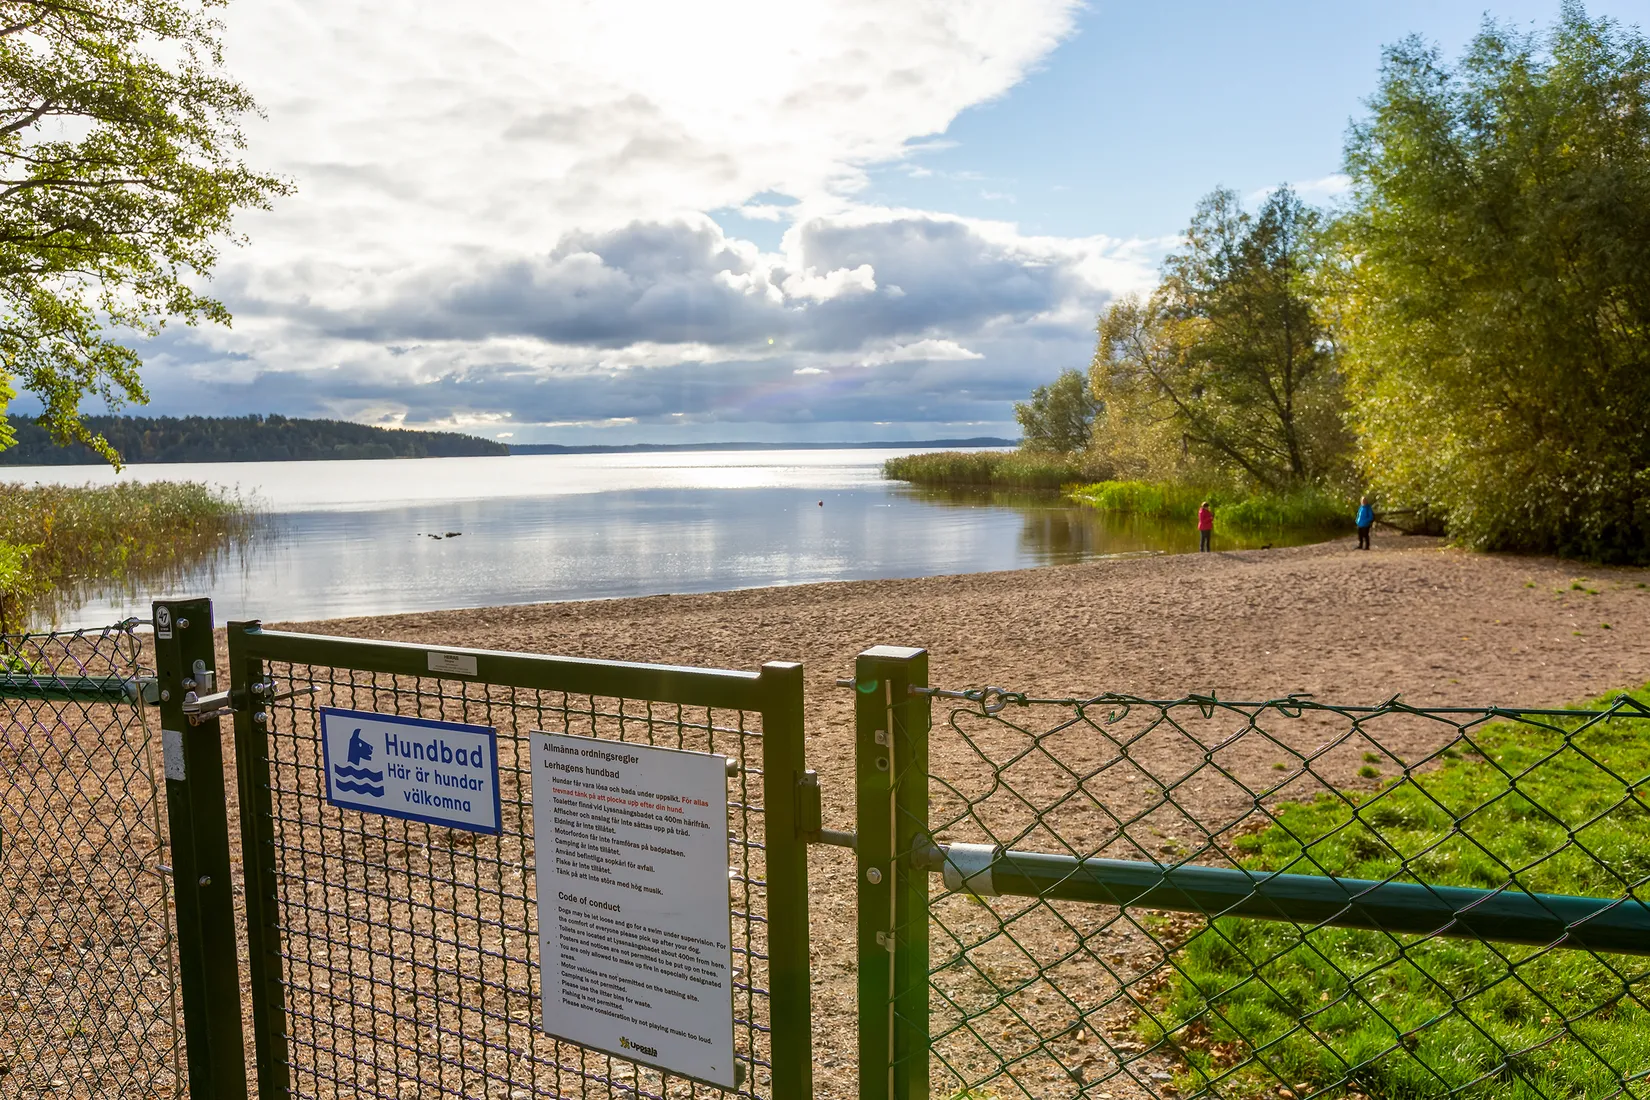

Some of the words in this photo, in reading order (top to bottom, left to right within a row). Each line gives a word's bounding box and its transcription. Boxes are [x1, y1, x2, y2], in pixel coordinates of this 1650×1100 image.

[385, 733, 484, 768] Hundbad
[543, 743, 580, 755] Allmänna
[580, 749, 639, 764] ordningsregler
[388, 763, 411, 780] Här
[416, 767, 430, 783] är
[435, 770, 484, 791] hundar
[543, 760, 585, 773] Lerhagens
[584, 766, 620, 779] hundbad
[404, 788, 471, 812] välkomna
[551, 776, 573, 785] Hundar
[572, 779, 582, 787] får
[595, 783, 609, 791] lösa
[620, 787, 636, 796] bada
[636, 791, 655, 799] under
[655, 794, 681, 803] uppsikt.
[681, 796, 692, 805] För
[693, 799, 709, 807] allas
[552, 787, 574, 796] trevnad
[574, 790, 588, 799] tänk
[588, 792, 596, 800] på
[596, 793, 606, 802] att
[606, 796, 627, 805] plocka
[627, 799, 640, 808] upp
[639, 801, 655, 809] efter
[655, 803, 666, 811] din
[666, 805, 685, 815] hund.
[552, 796, 578, 807] Toaletter
[578, 801, 593, 810] finns
[592, 803, 603, 811] vid
[663, 815, 683, 825] 400m
[683, 818, 711, 829] härifrån.
[553, 807, 579, 817] Affischer
[590, 814, 611, 824] anslag
[610, 816, 620, 824] får
[620, 818, 633, 827] inte
[633, 821, 653, 830] sättas
[653, 825, 666, 833] upp
[666, 826, 675, 834] på
[675, 828, 691, 837] träd.
[553, 817, 575, 828] Eldning
[575, 820, 582, 828] är
[582, 821, 594, 830] inte
[594, 824, 617, 834] tillåtet.
[554, 827, 589, 839] Motorfordon
[589, 833, 598, 841] får
[598, 835, 611, 844] inte
[611, 838, 640, 849] framföras
[640, 843, 649, 851] på
[649, 845, 686, 857] badplatsen.
[554, 837, 580, 849] Camping
[580, 841, 587, 850] är
[587, 843, 599, 852] inte
[599, 846, 621, 856] tillåtet.
[555, 847, 576, 857] Använd
[627, 861, 636, 869] för
[636, 864, 655, 873] avfall.
[555, 857, 571, 866] Fiske
[571, 860, 578, 868] är
[578, 861, 590, 870] inte
[590, 864, 612, 875] tillåtet.
[555, 867, 570, 876] Tänk
[570, 870, 578, 878] på
[578, 872, 588, 880] att
[588, 873, 600, 882] inte
[600, 877, 616, 886] störa
[616, 881, 630, 889] med
[630, 882, 643, 892] hög
[642, 886, 664, 895] musik.
[558, 891, 578, 903] Code
[579, 896, 588, 905] of
[588, 899, 621, 912] conduct
[557, 906, 572, 915] Dogs
[571, 910, 583, 918] may
[583, 911, 591, 919] be
[590, 913, 599, 921] let
[599, 915, 614, 924] loose
[633, 923, 642, 931] for
[647, 927, 663, 935] swim
[663, 931, 680, 939] under
[680, 935, 716, 947] supervision.
[716, 941, 727, 950] For
[559, 933, 579, 944] Posters
[579, 939, 590, 947] and
[590, 942, 610, 951] notices
[620, 949, 630, 957] not
[630, 952, 658, 963] permitted
[657, 956, 665, 965] to
[664, 959, 673, 967] be
[672, 961, 684, 970] put
[683, 963, 692, 972] up
[692, 965, 701, 974] on
[700, 968, 719, 978] trees.
[559, 942, 570, 951] You
[579, 948, 591, 957] only
[590, 951, 612, 961] allowed
[612, 955, 618, 963] to
[618, 958, 634, 966] make
[642, 963, 653, 971] fire
[653, 965, 660, 973] in
[659, 967, 689, 980] especially
[688, 975, 722, 988] designated
[560, 952, 577, 961] areas.
[560, 961, 576, 970] Motor
[576, 966, 598, 976] vehicles
[617, 975, 645, 988] permitted
[653, 985, 664, 993] the
[663, 988, 686, 999] bathing
[686, 994, 700, 1002] site.
[560, 970, 584, 982] Camping
[589, 978, 600, 986] not
[599, 981, 628, 993] permitted.
[561, 979, 579, 989] Please
[589, 987, 599, 995] the
[599, 989, 613, 999] litter
[612, 993, 625, 1002] bins
[625, 996, 634, 1004] for
[633, 1000, 653, 1009] waste.
[561, 988, 581, 1000] Fishing
[580, 993, 586, 1001] is
[586, 994, 596, 1003] not
[596, 999, 624, 1010] permitted.
[562, 997, 580, 1007] Please
[579, 1003, 594, 1011] show
[594, 1008, 631, 1022] consideration
[630, 1016, 638, 1024] by
[638, 1019, 648, 1027] not
[648, 1022, 669, 1033] playing
[669, 1028, 687, 1037] music
[687, 1032, 698, 1040] too
[698, 1035, 713, 1045] loud.
[630, 1041, 658, 1056] Uppsala
